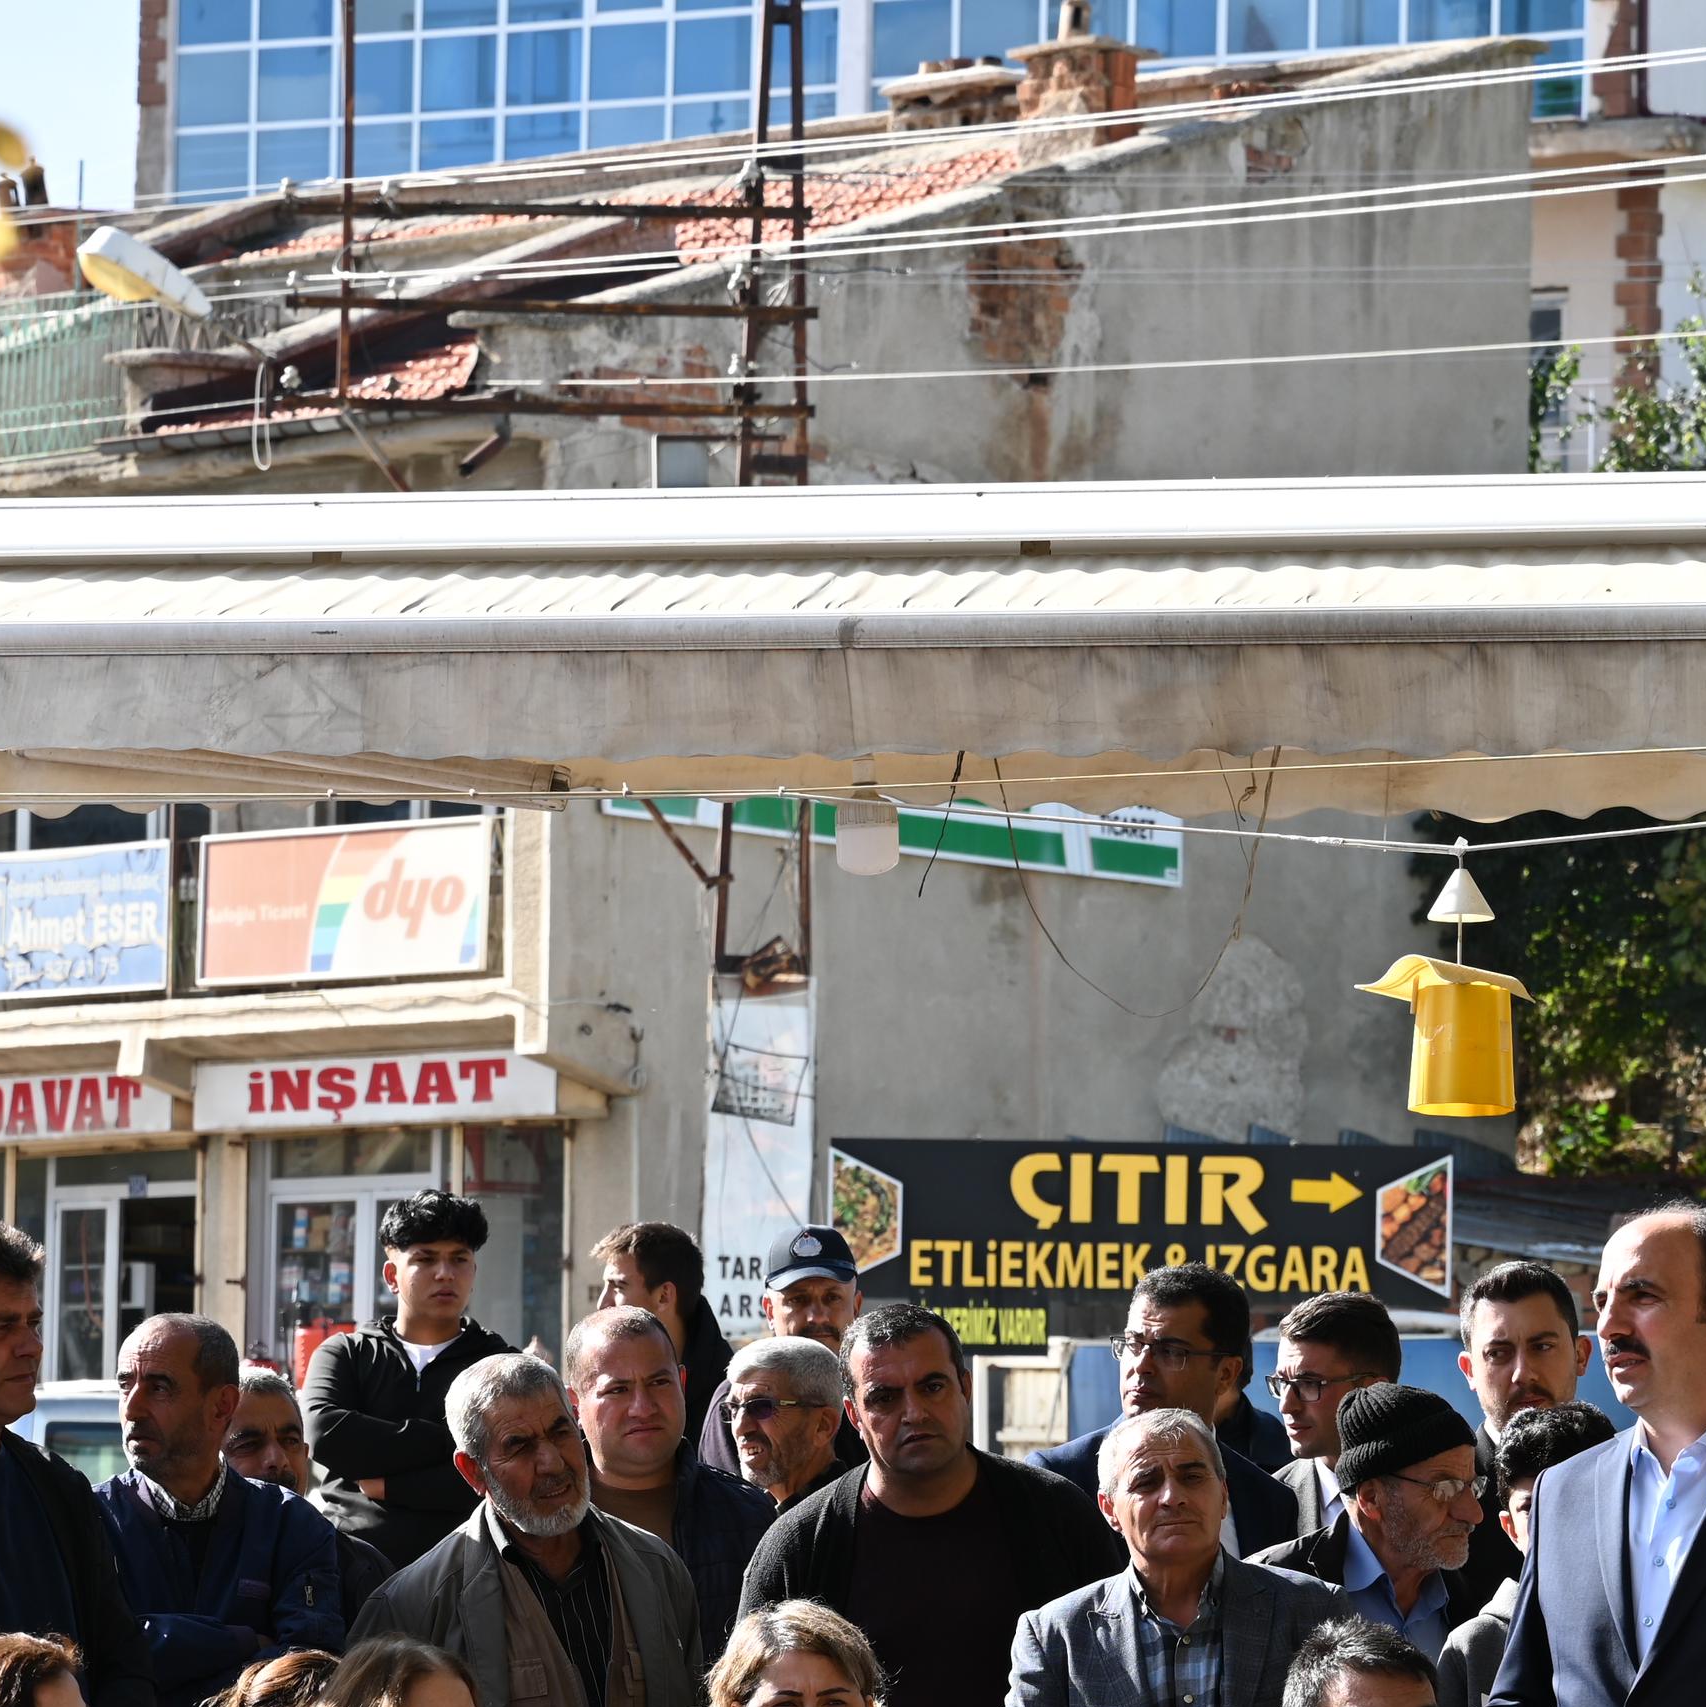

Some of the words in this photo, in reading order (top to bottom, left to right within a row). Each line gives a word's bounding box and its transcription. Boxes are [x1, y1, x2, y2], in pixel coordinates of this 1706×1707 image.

[7, 906, 87, 952] Ahmet
[94, 901, 158, 945] ESER
[363, 857, 466, 939] dyo
[1009, 1152, 1269, 1236] ÇITIR
[1205, 1243, 1371, 1293] IZGARA
